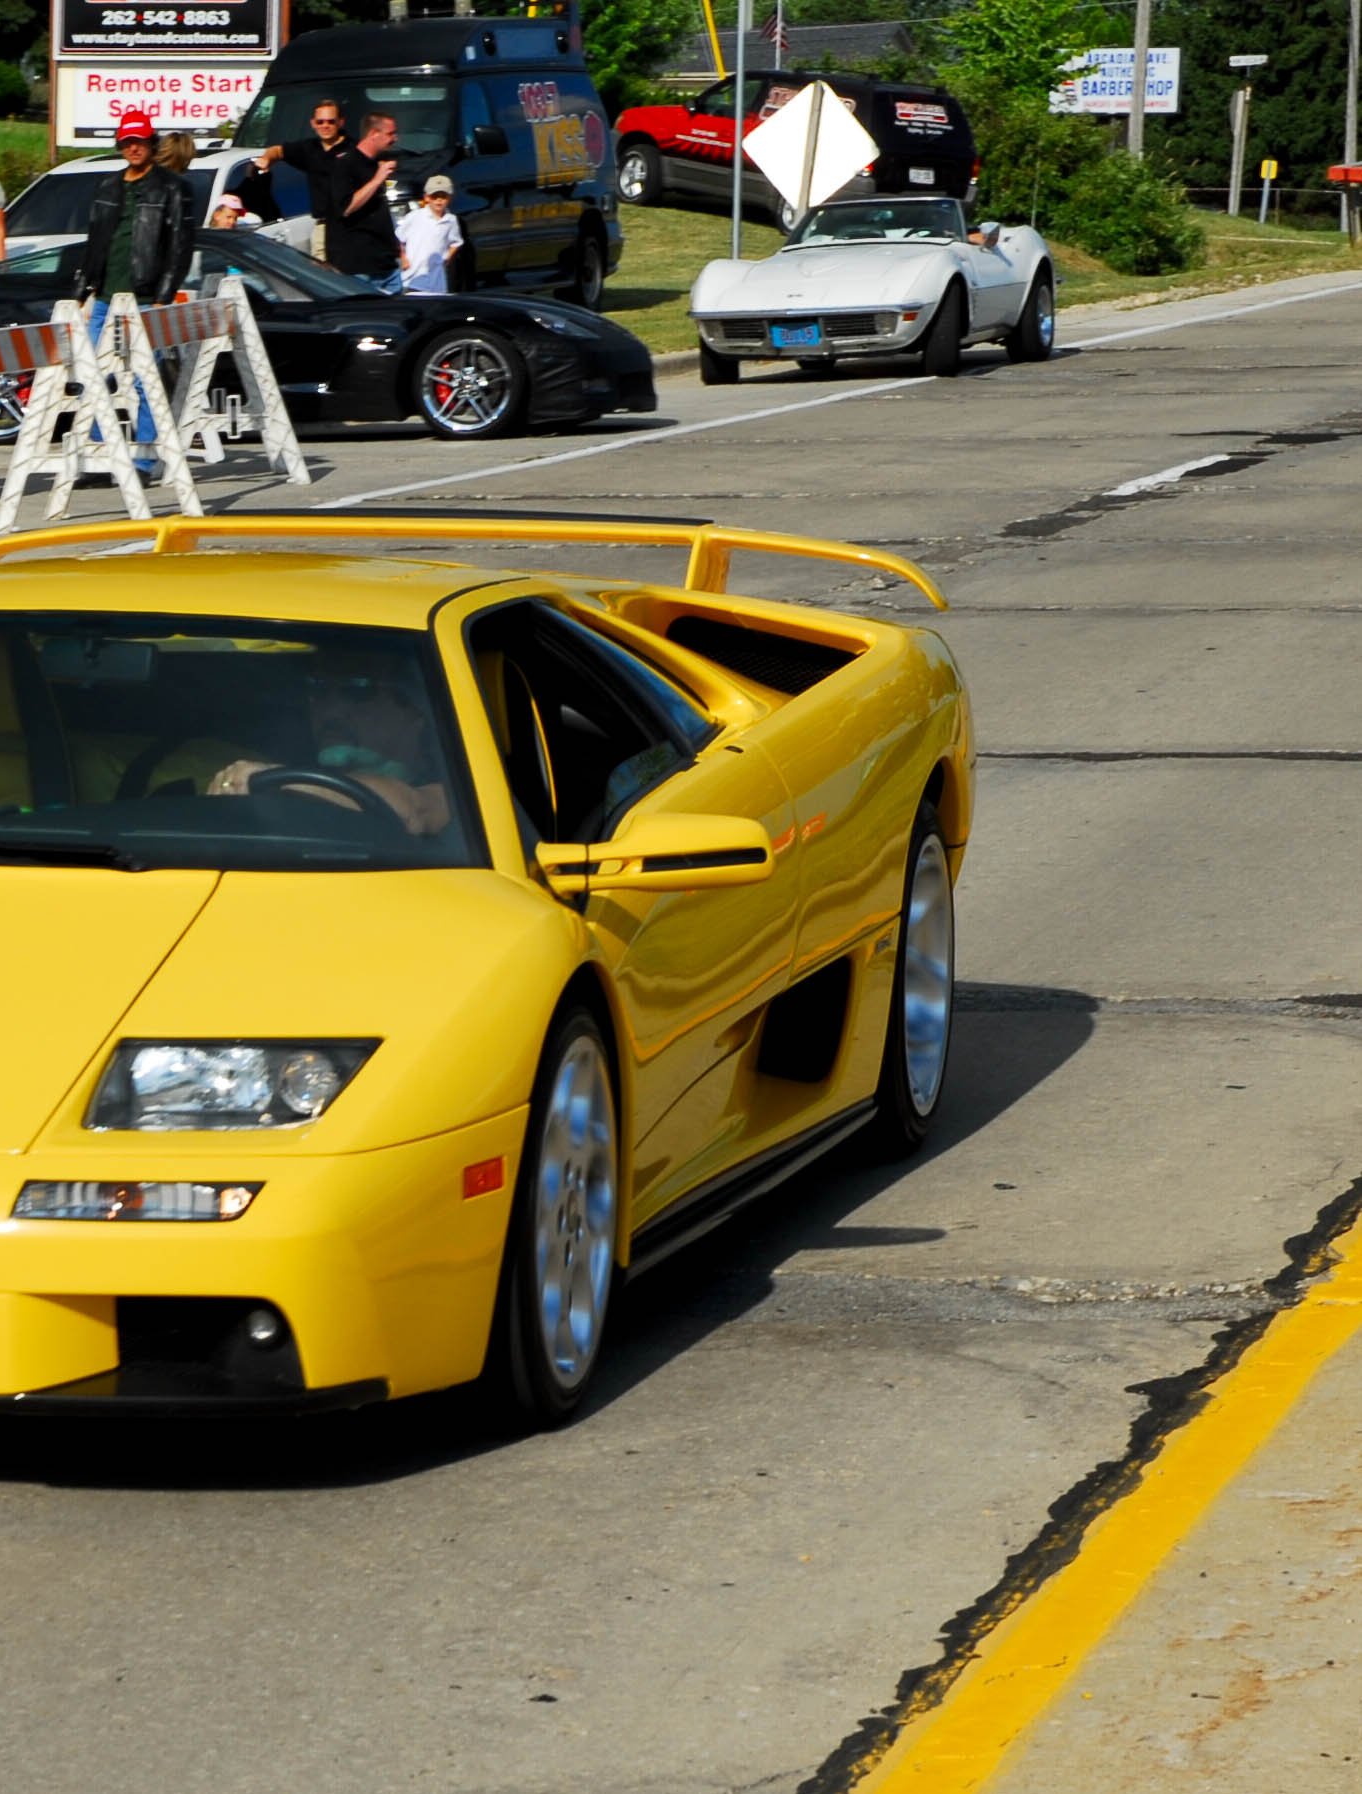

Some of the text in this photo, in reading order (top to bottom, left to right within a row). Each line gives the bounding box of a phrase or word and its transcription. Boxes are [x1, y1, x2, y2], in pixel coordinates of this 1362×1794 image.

[101, 10, 137, 26] 262
[143, 10, 178, 26] 542
[71, 32, 259, 47] www.staytunedcustoms.com
[87, 74, 253, 93] Remote Start
[1082, 81, 1134, 96] BARBER
[109, 99, 229, 118] Sold Here
